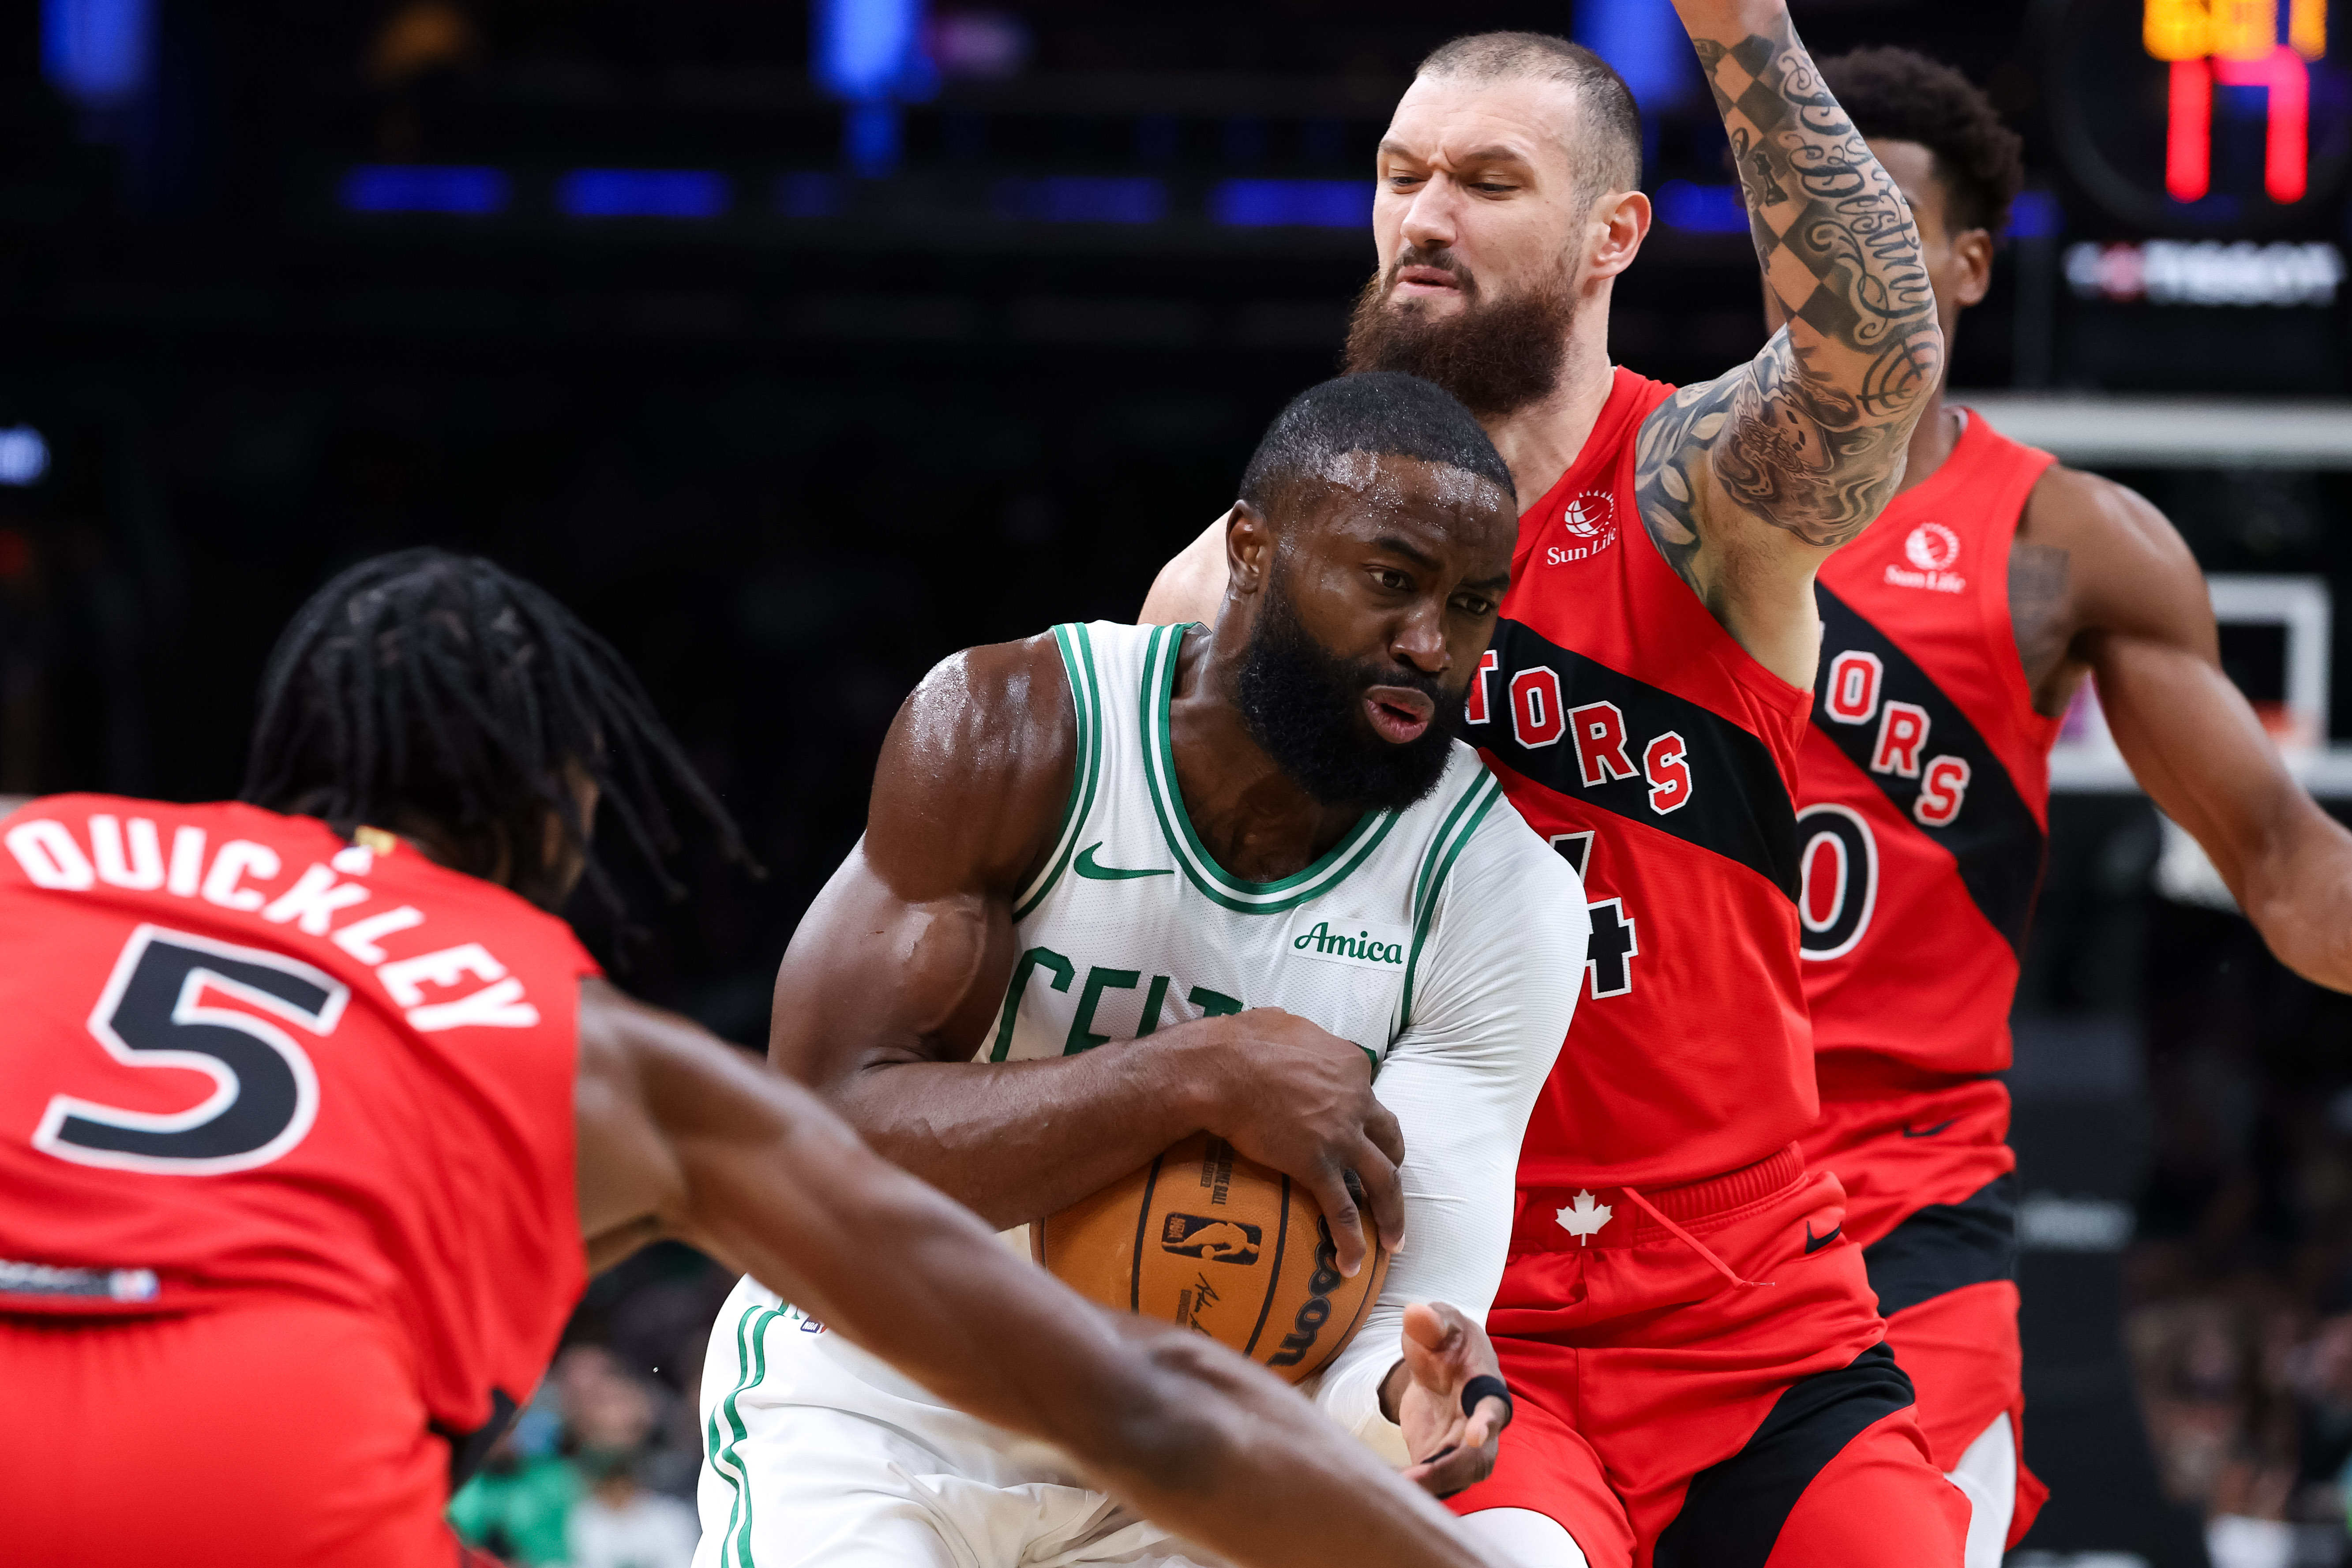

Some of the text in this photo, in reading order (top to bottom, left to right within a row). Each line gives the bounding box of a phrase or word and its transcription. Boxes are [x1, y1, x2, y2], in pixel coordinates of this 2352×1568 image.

[1547, 547, 1587, 565] Sun
[1465, 649, 1692, 815] TORS
[4, 814, 539, 1032] QUICKLEY
[1294, 922, 1403, 964] Amica
[32, 922, 351, 1175] 5
[802, 1321, 819, 1331] NBA
